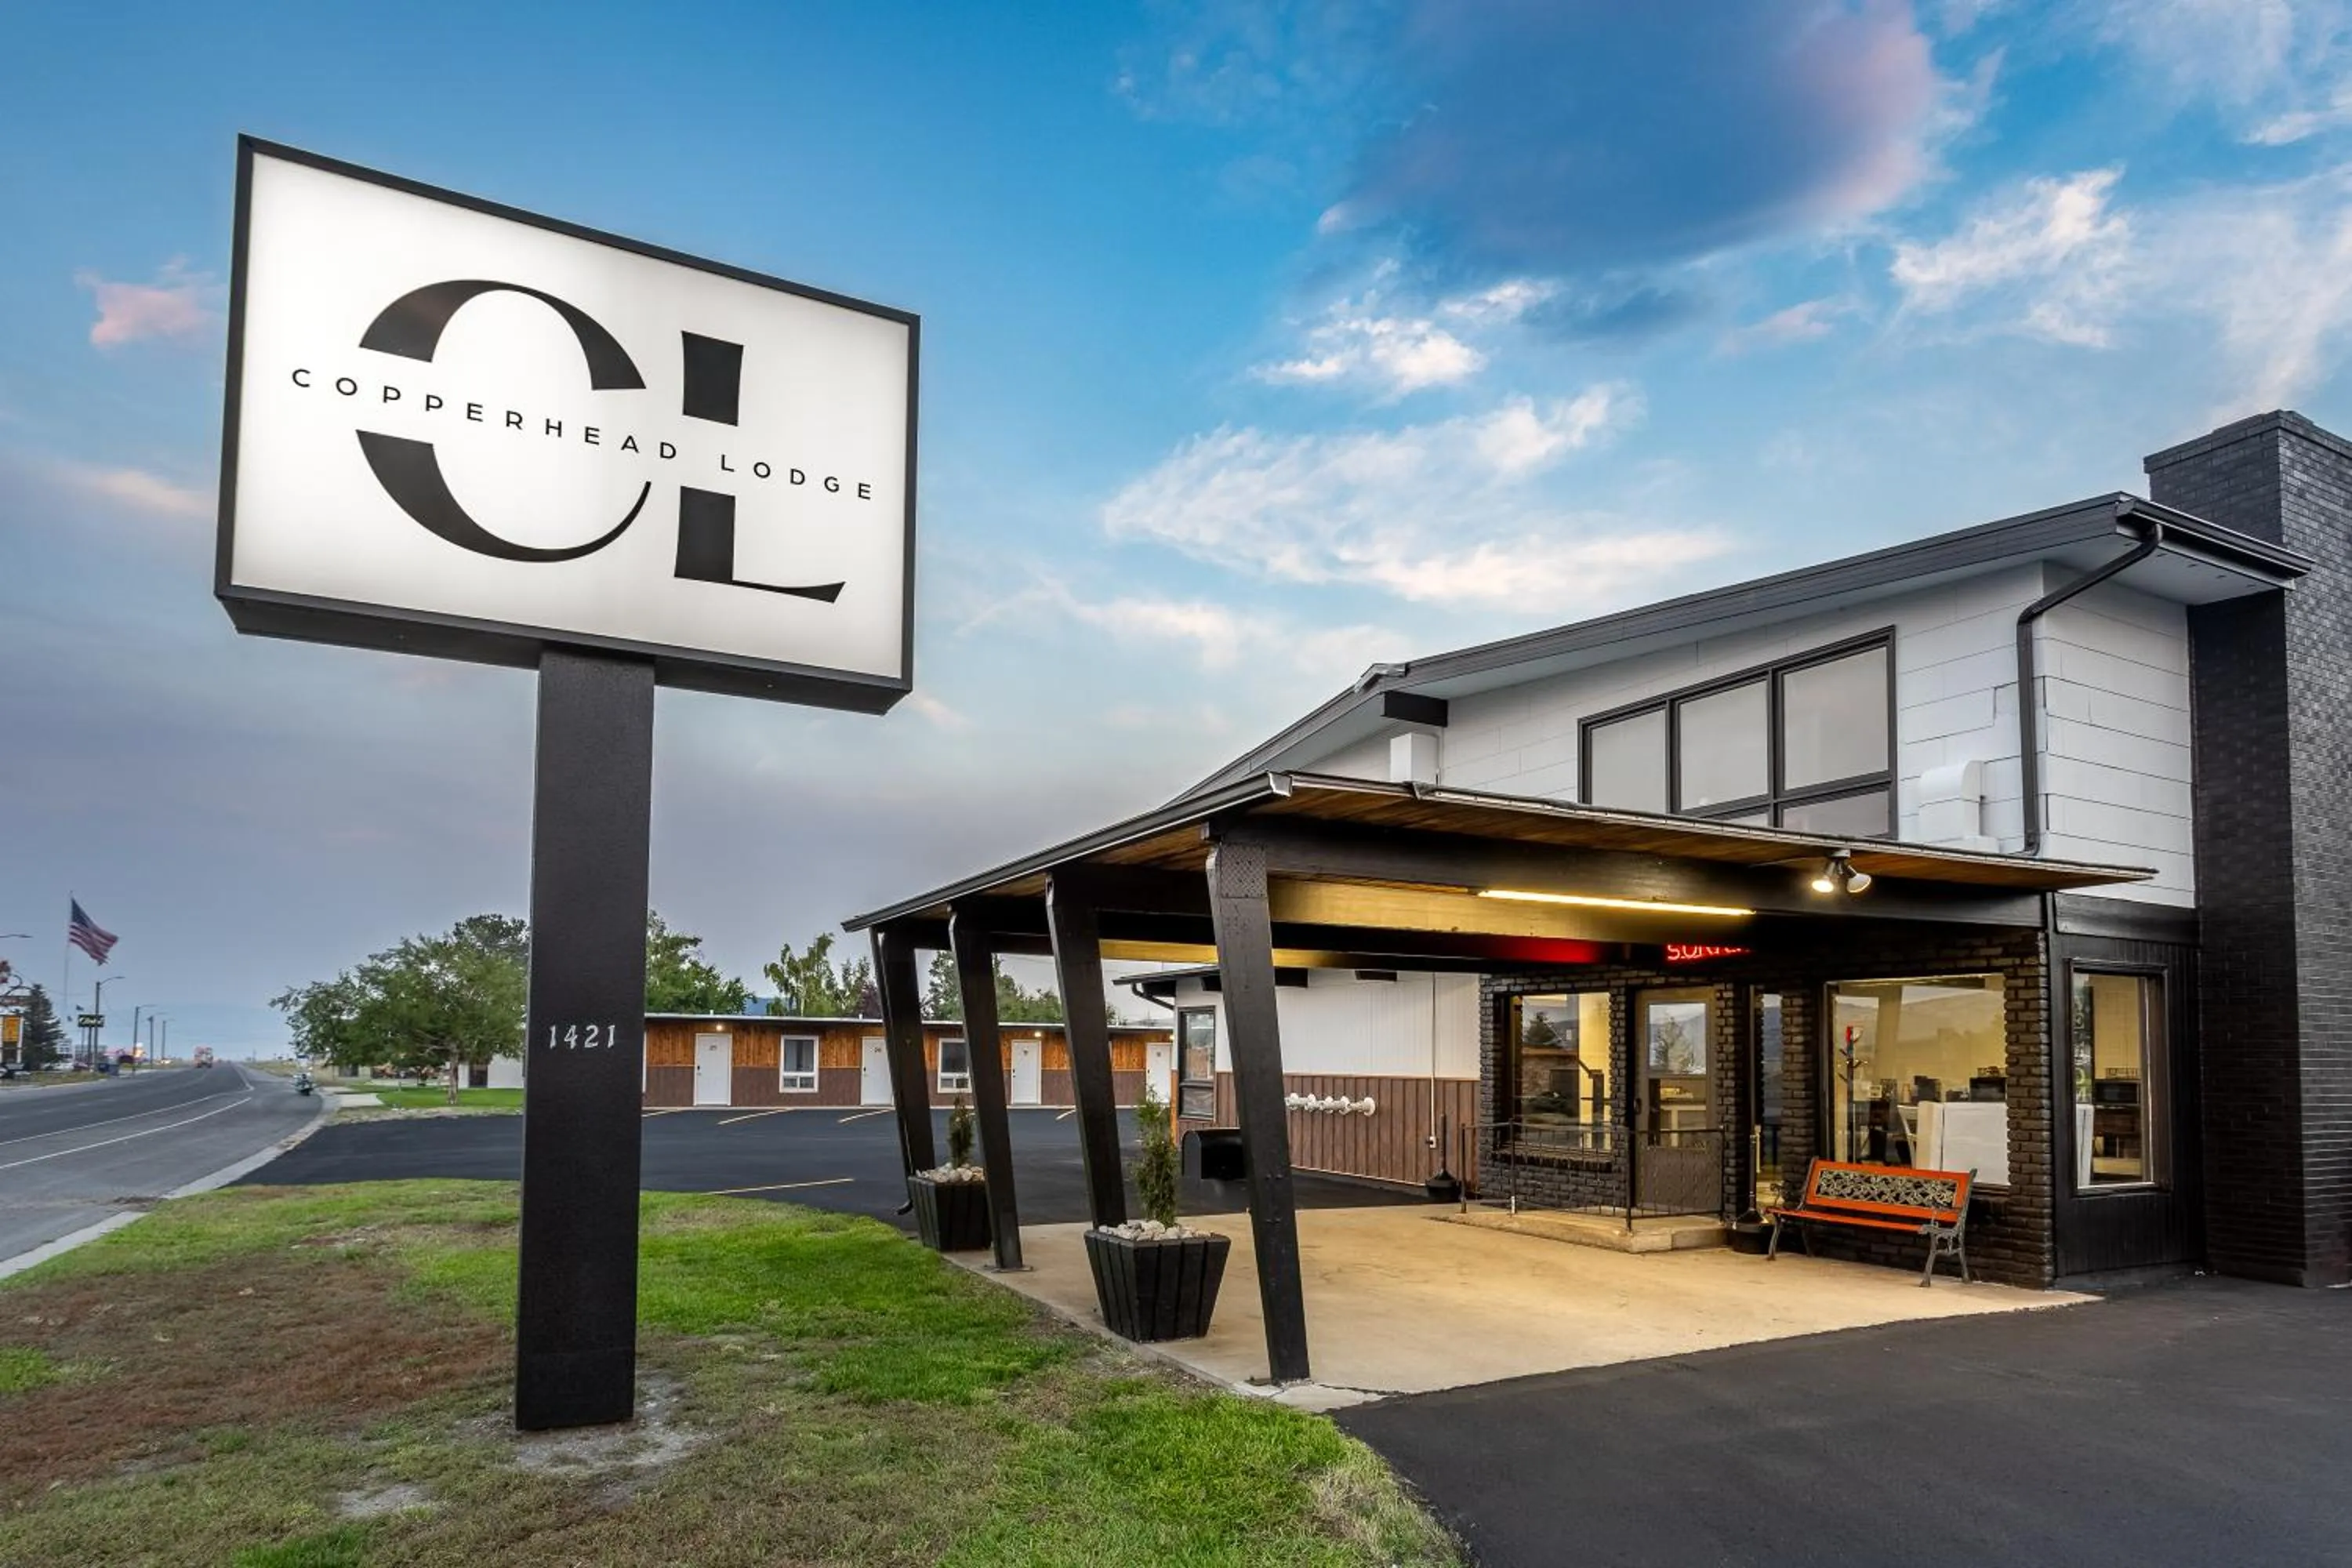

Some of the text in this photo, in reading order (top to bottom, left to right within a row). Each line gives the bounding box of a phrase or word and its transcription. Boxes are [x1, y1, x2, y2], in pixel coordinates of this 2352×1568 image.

[292, 368, 871, 500] COPPERHEAD LODGE
[357, 281, 845, 604] CL
[550, 1024, 615, 1049] 1421
